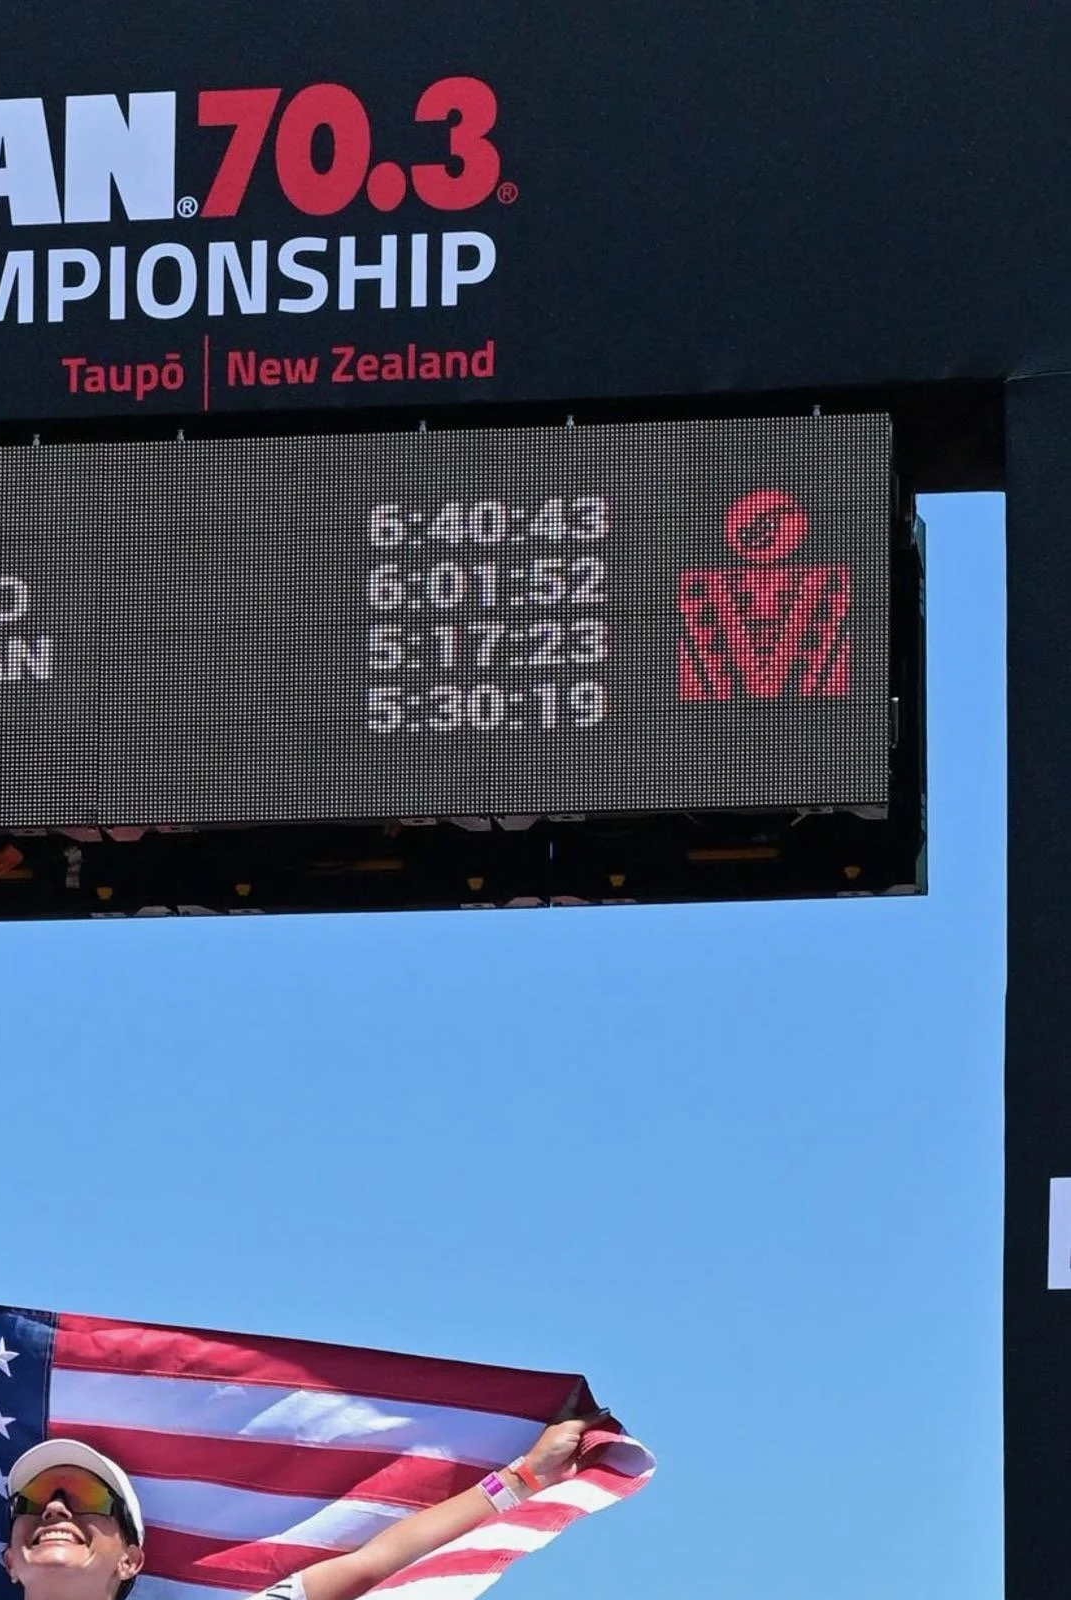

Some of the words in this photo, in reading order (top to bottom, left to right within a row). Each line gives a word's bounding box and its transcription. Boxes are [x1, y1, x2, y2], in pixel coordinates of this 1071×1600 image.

[198, 76, 499, 217] 70.3
[61, 351, 185, 394] Taupō
[226, 349, 318, 387] New
[331, 341, 496, 383] Zealand
[370, 496, 611, 547] 6:40:43
[369, 557, 607, 611] 6:01:52
[368, 618, 610, 671] 5:17:23
[367, 681, 609, 735] 5:30:19
